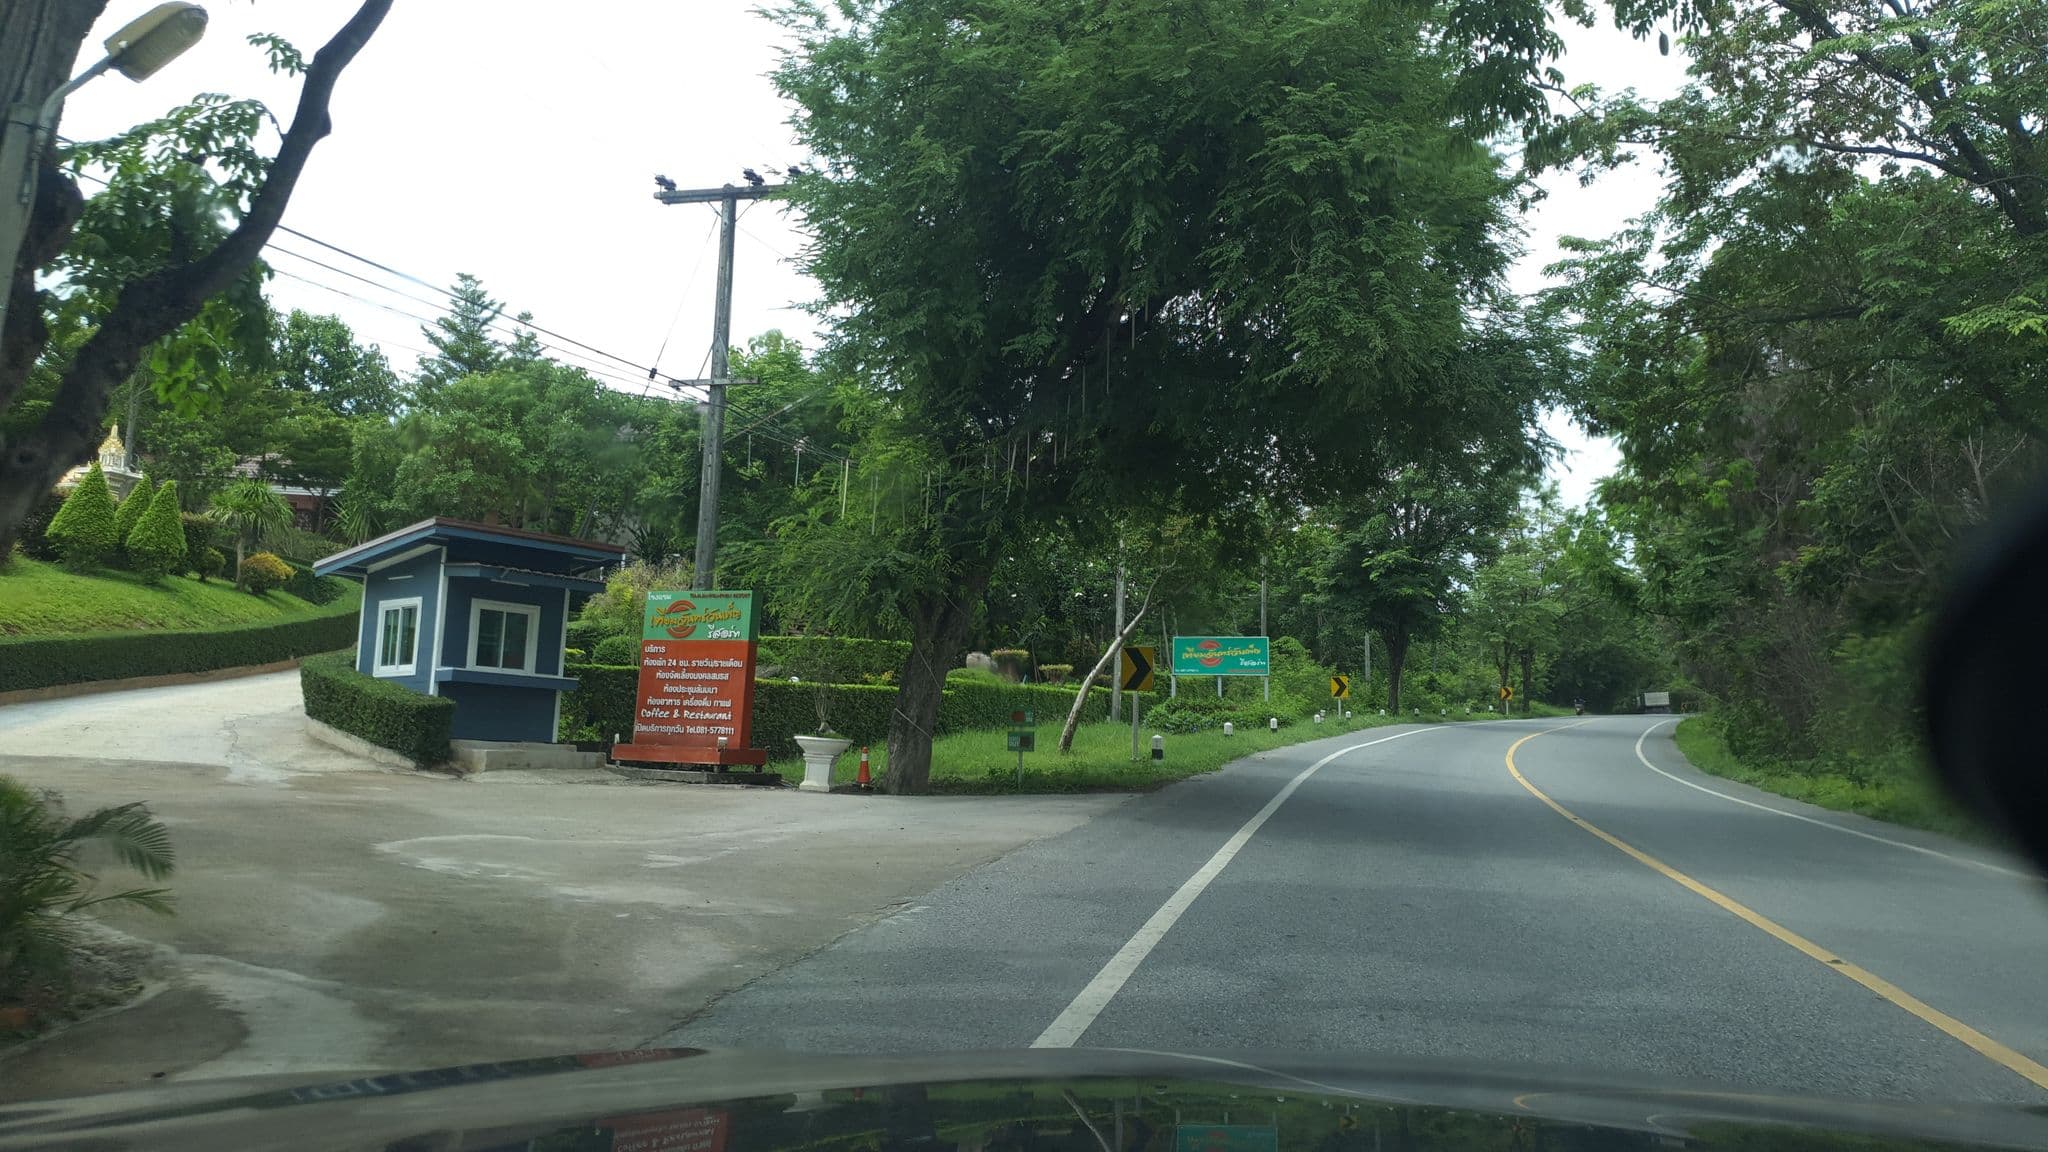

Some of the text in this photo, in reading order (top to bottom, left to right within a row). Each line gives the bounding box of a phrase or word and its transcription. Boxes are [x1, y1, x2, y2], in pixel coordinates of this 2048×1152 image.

[647, 591, 672, 600] โรงแรม
[707, 624, 741, 639] รีสอร์ท
[644, 644, 666, 653] บริการ
[643, 657, 667, 667] ห้องพัก
[667, 658, 677, 667] 24
[663, 683, 718, 695] ห้องประชุมสัมมนา
[647, 695, 732, 708] ห้องอาหาร เครื่องดื่ม กาแฟ
[640, 707, 733, 721] Coffee & Restaurant
